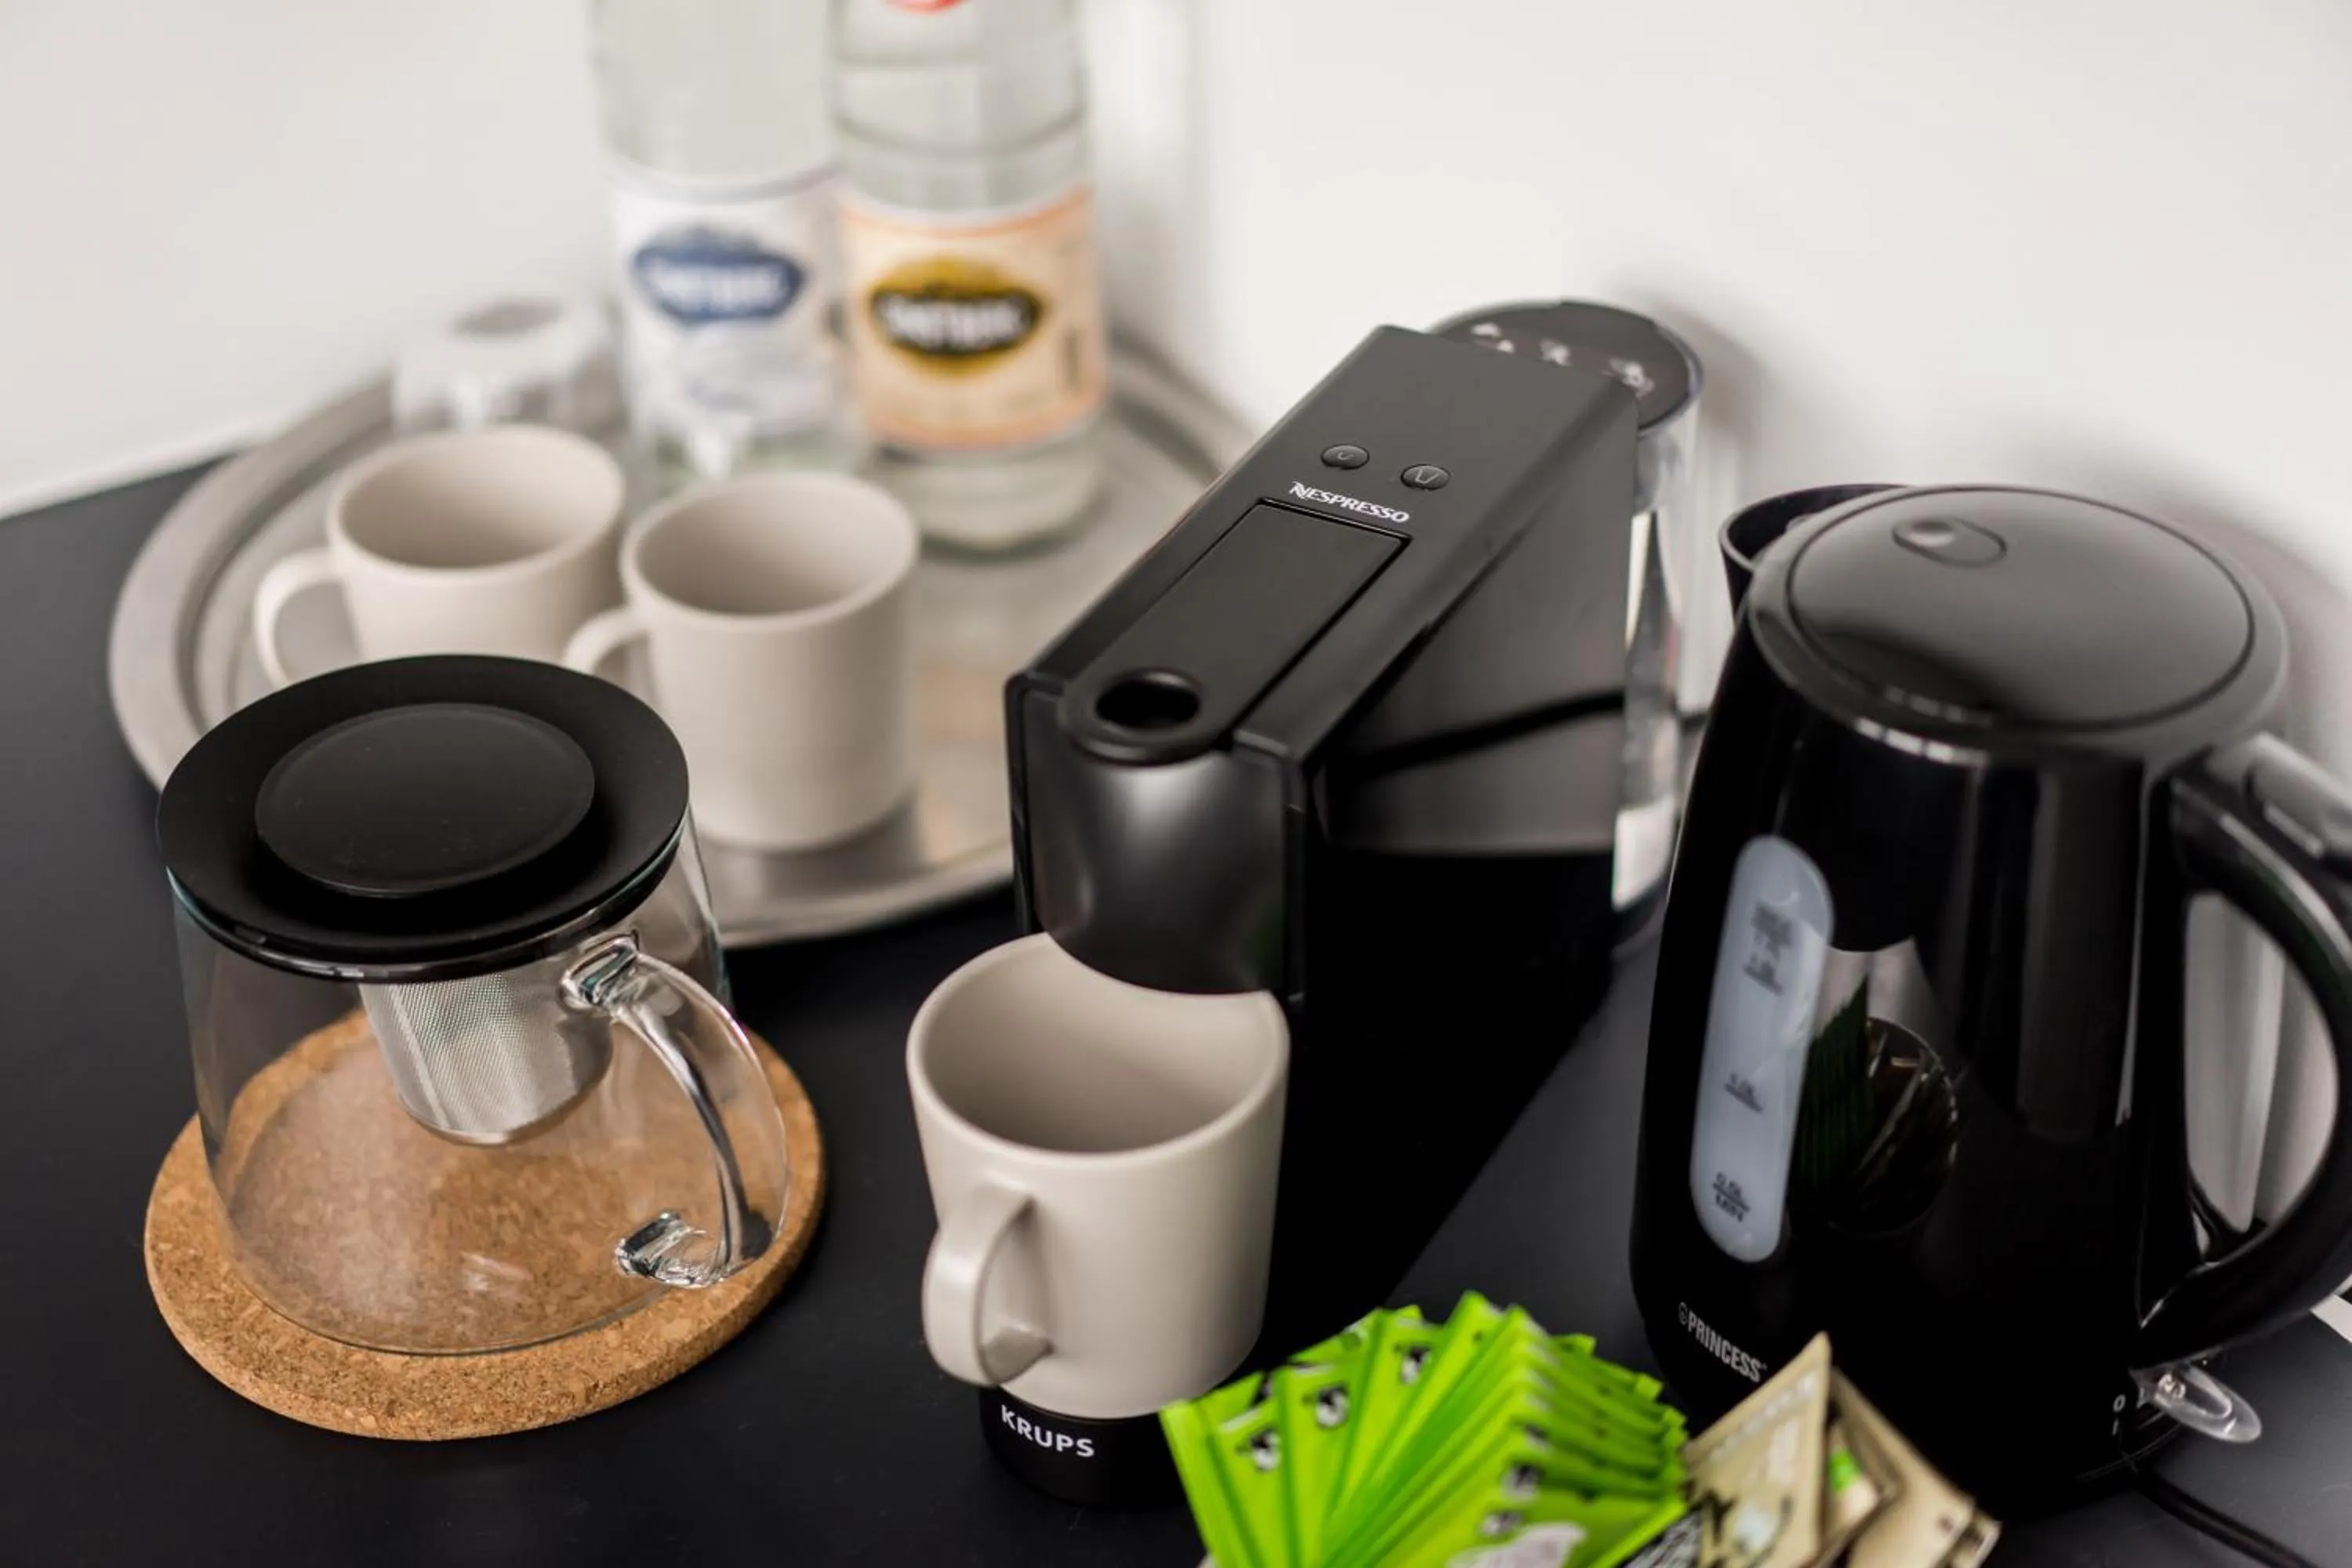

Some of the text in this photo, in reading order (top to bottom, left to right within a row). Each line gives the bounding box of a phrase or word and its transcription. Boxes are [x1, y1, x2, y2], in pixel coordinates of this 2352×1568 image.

[1288, 480, 1410, 524] NESPRESSO
[1687, 1308, 1761, 1384] PRINCESS
[1001, 1403, 1095, 1458] KRUPS
